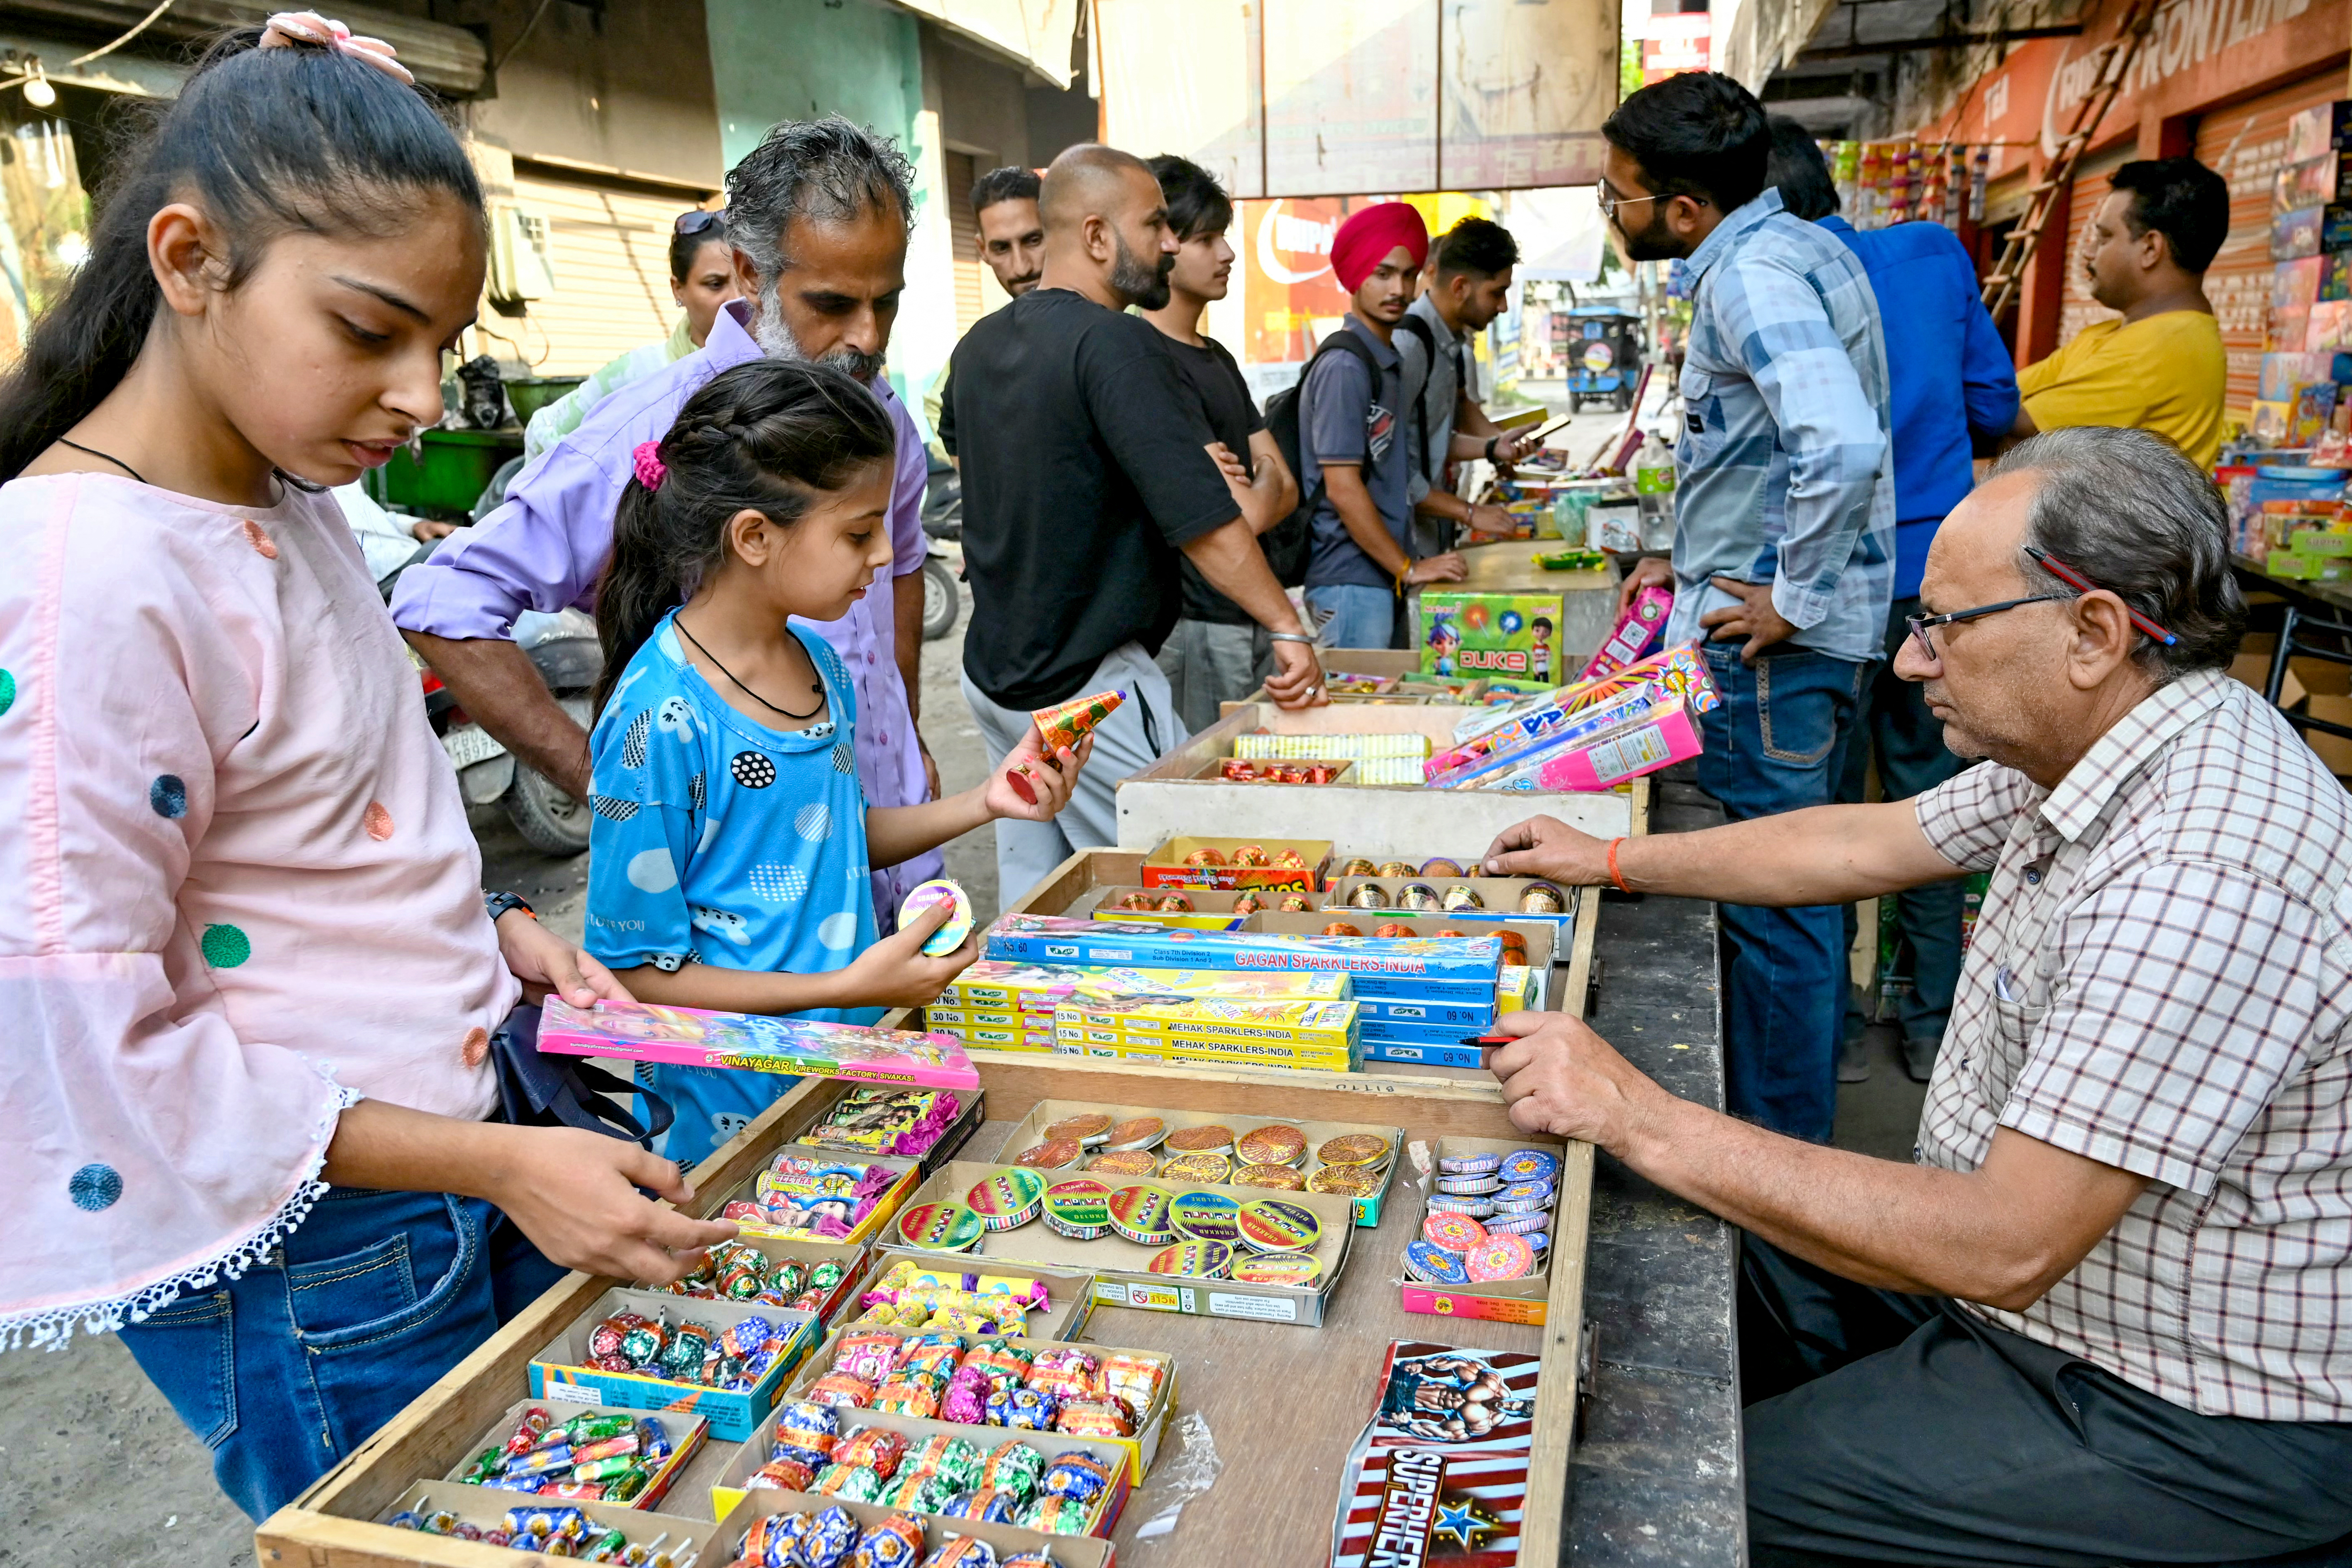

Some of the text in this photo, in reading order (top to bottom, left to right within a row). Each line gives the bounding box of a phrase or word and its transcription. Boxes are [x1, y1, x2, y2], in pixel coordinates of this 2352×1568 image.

[618, 919, 645, 932] YOU
[1018, 942, 1027, 953] 60
[1235, 951, 1426, 974] GAGAN SPARKLERS-INDIA
[1102, 973, 1145, 992] SPARKLERS
[943, 996, 957, 1006] No.
[933, 1012, 944, 1021] 30
[947, 1013, 961, 1022] No.
[1447, 1011, 1474, 1021] No. 60
[948, 1029, 962, 1038] No.
[1170, 1023, 1204, 1033] MEHAK
[1206, 1026, 1292, 1039] SPARKLERS-INDIA
[569, 1042, 644, 1053] sunindiyafireworks@gmail.com
[1172, 1040, 1206, 1050] MEHAK
[1208, 1043, 1294, 1057] SPARKLERS-INDIA
[1456, 1053, 1470, 1064] No.
[720, 1054, 916, 1082] VINAYAGAR FIREWORKS FACTORY, SIVAKASI.
[1336, 1084, 1394, 1092] BITTU
[1502, 1150, 1549, 1165] GROUND CHAKKAR
[774, 1175, 812, 1185] GEETHA
[1023, 1175, 1036, 1193] DELUXE
[974, 1189, 987, 1209] CHAKKAR
[994, 1175, 1018, 1209] VADIVEL
[1114, 1191, 1130, 1210] CHAKKAR
[1134, 1192, 1160, 1226] VADIVEL
[1182, 1211, 1237, 1220] ADIVEL
[1281, 1205, 1310, 1221] DELUXE
[907, 1210, 924, 1231] CHAKKAR
[927, 1208, 956, 1243] VADIVEL
[960, 1219, 974, 1239] DELUXE
[1253, 1208, 1308, 1238] VADIVEL
[1458, 1216, 1480, 1233] GROUND
[1246, 1221, 1278, 1243] CHAKKAR
[1426, 1223, 1436, 1238] ASORA
[1211, 1247, 1221, 1263] DELUXE
[1468, 1246, 1479, 1267] ASORA
[1513, 1239, 1526, 1260] GROUND
[1181, 1245, 1198, 1275] VADIVEL
[1151, 1296, 1175, 1304] NCLE
